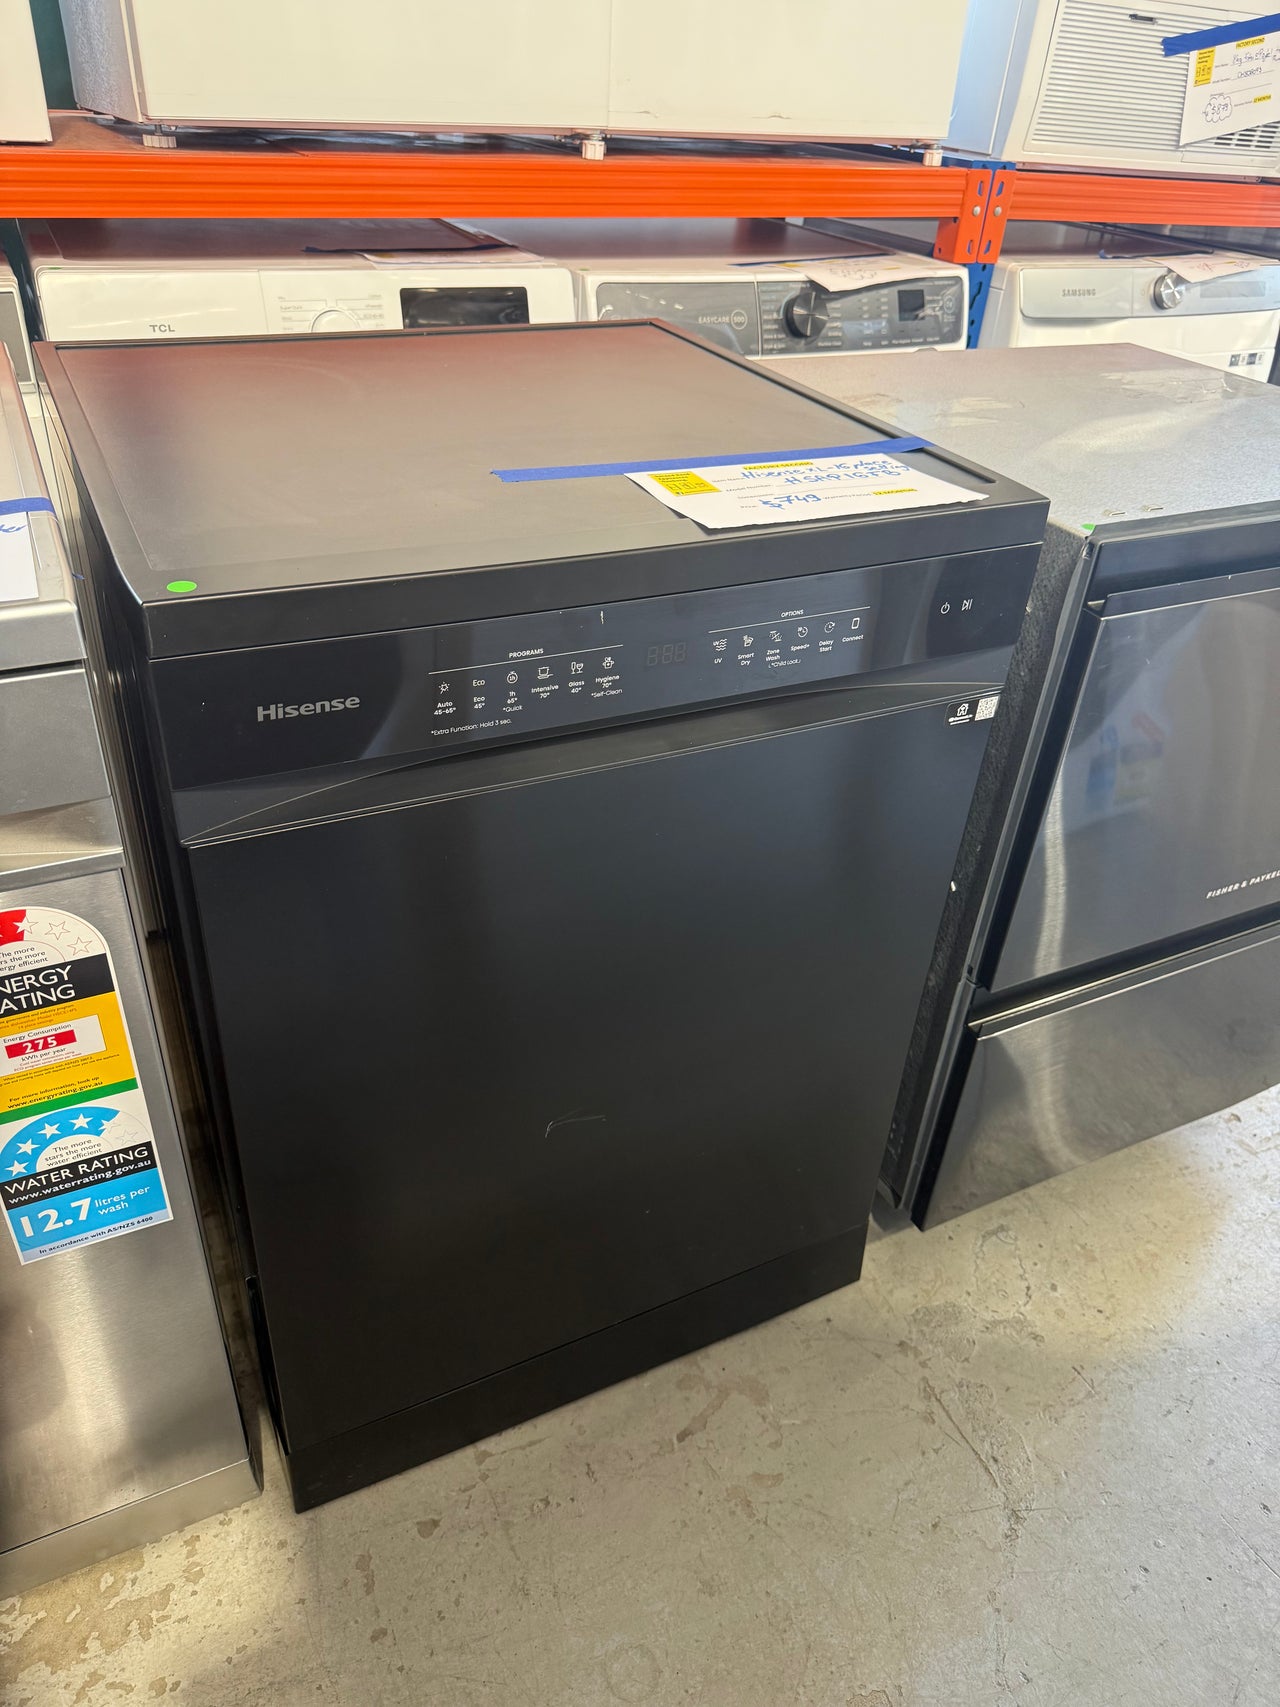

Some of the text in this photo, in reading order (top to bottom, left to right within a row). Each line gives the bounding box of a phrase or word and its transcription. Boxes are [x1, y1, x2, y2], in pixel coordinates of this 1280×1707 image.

[1061, 288, 1096, 298] SAMSUNG
[698, 316, 730, 324] EASYCARE
[149, 324, 176, 333] TCL
[758, 494, 822, 510] $749
[781, 609, 804, 618] OPTIONS
[842, 634, 864, 642] Connect
[508, 648, 544, 658] PROGRAMS
[738, 652, 754, 660] Smart
[472, 679, 486, 687] Eco
[568, 680, 585, 688] Glass
[596, 674, 620, 684] Hygiene
[531, 684, 559, 694] Intensive
[256, 696, 360, 722] Hisense
[434, 707, 457, 716] 45-65°
[450, 724, 479, 734] Function:
[1206, 883, 1240, 899] FISHER
[1240, 880, 1248, 888] &
[14, 946, 35, 956] more
[24, 951, 46, 960] more
[18, 957, 48, 968] efficient
[3, 1023, 72, 1044] Energy Consumption
[22, 1036, 58, 1054] 275
[21, 1047, 67, 1062] kWh per year
[40, 1083, 76, 1095] information,
[7, 1081, 104, 1109] www.energyrating.gov.au
[52, 1139, 92, 1153] The more
[44, 1153, 64, 1162] stars
[80, 1142, 102, 1152] more
[46, 1148, 102, 1167] water efficient
[4, 1146, 148, 1194] WATER RATING
[8, 1159, 152, 1205] www.waterrating.gov.au
[20, 1186, 150, 1238] 12.7 litres per
[98, 1201, 129, 1216] wash
[48, 1235, 89, 1252] accordance
[90, 1229, 106, 1240] with
[107, 1220, 136, 1234] AS/NZS
[136, 1216, 153, 1226] 6400
